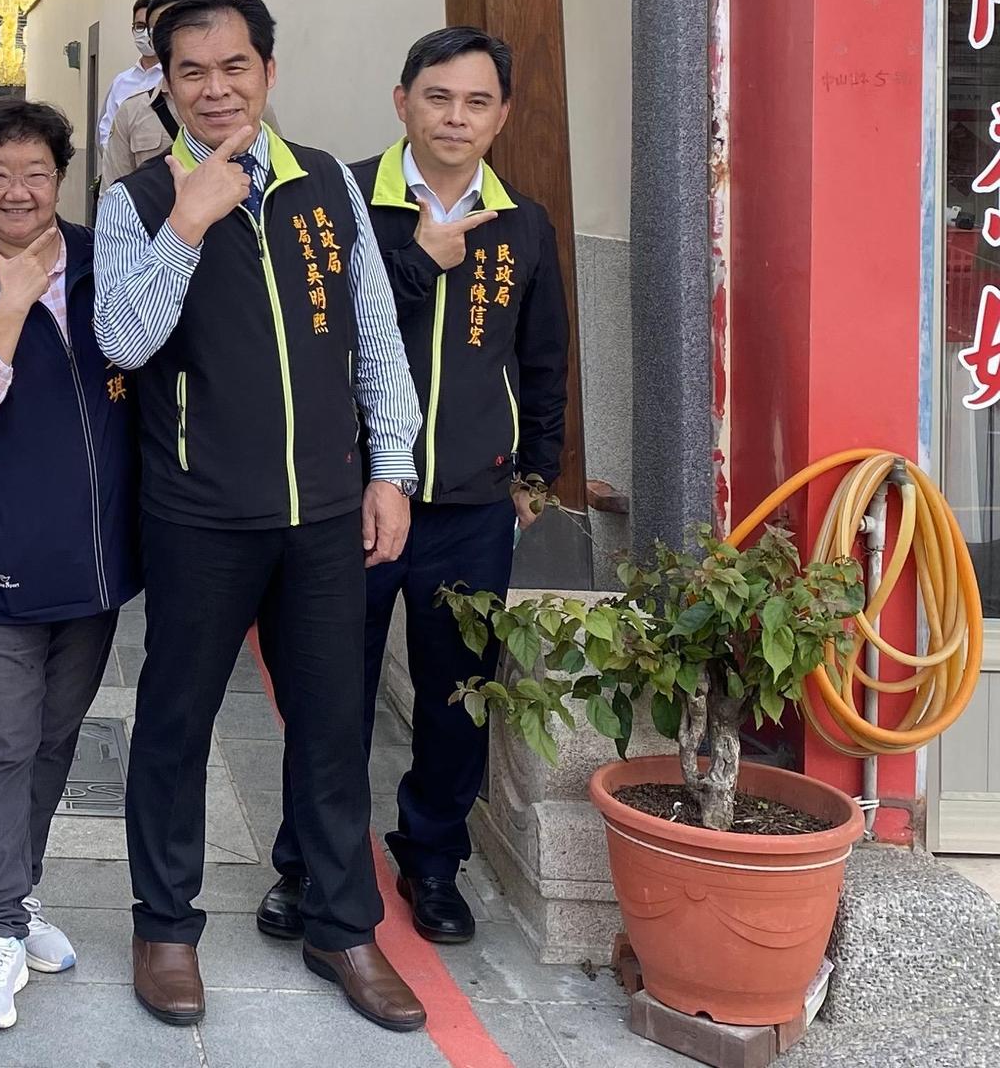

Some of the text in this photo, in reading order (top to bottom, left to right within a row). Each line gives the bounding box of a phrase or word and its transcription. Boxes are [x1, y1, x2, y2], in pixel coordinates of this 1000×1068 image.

[312, 206, 341, 274] 民政局
[467, 248, 490, 347] 科長陳信宏
[494, 243, 515, 308] 民政局
